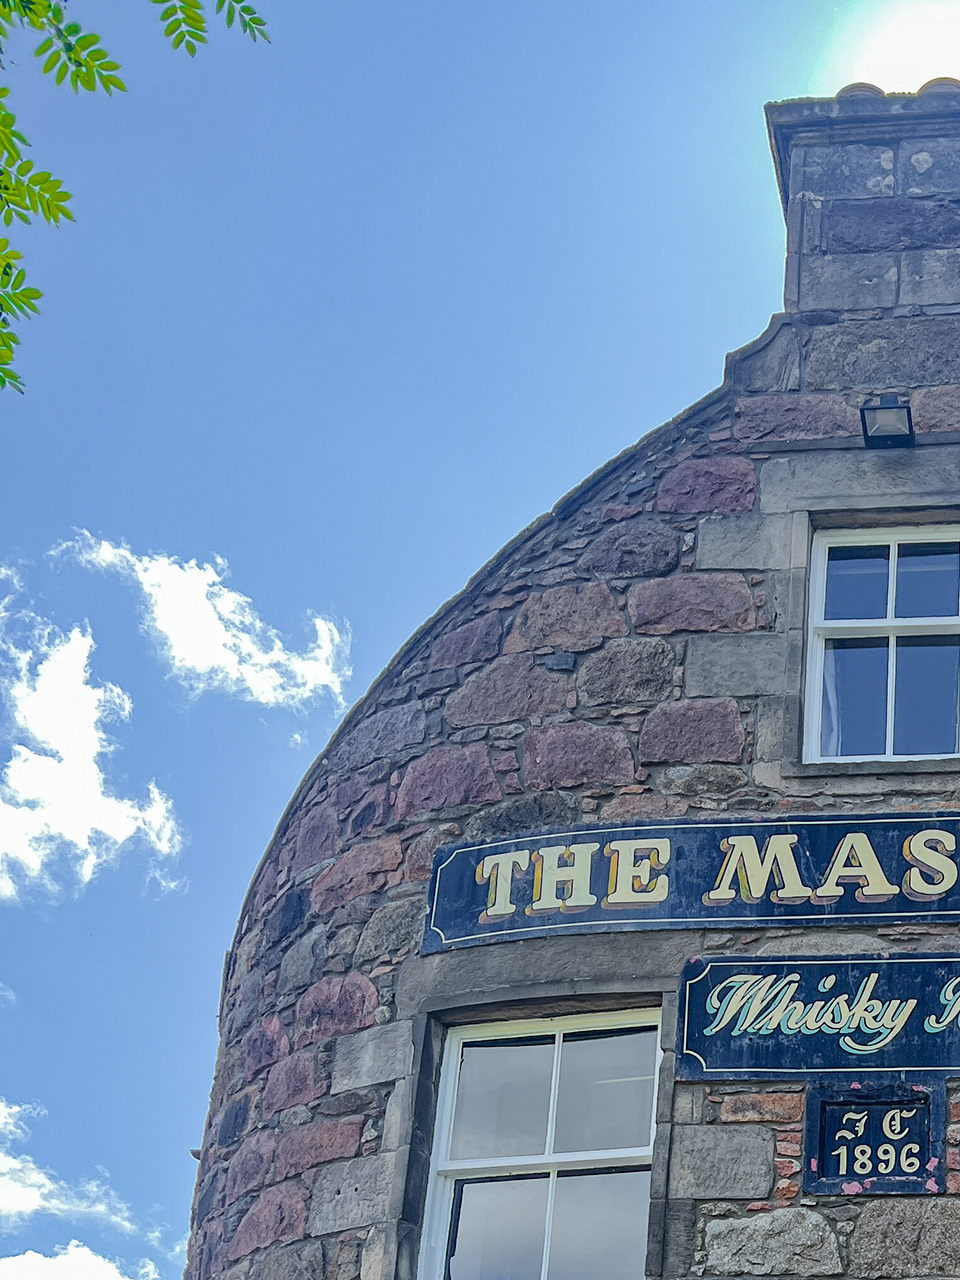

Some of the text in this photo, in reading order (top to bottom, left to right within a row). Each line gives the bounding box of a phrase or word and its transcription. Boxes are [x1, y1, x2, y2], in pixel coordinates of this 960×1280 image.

[475, 838, 671, 924] THE
[704, 973, 917, 1054] Whisky
[831, 1143, 920, 1176] 1896
